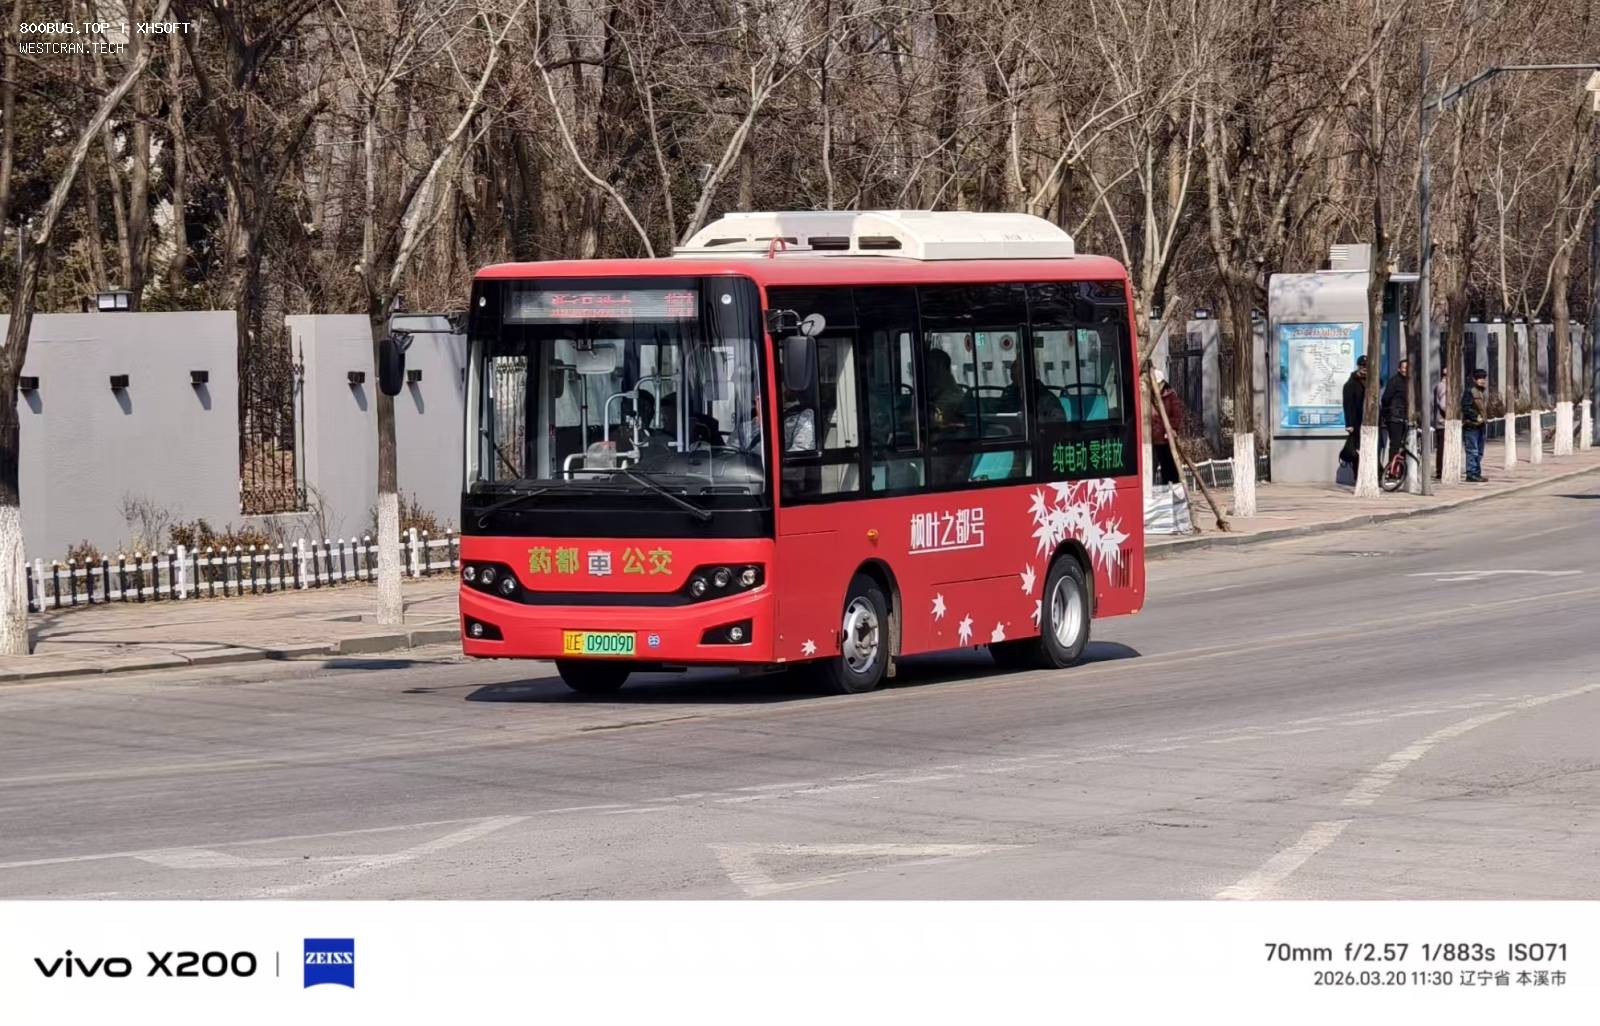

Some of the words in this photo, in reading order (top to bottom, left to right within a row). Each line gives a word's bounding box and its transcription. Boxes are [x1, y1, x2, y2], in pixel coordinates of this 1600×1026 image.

[1052, 440, 1087, 473] 纯电动
[1089, 437, 1124, 470] 零排放
[909, 507, 985, 552] 枫叶之都号
[527, 545, 580, 575] 药都
[621, 546, 673, 576] 公交
